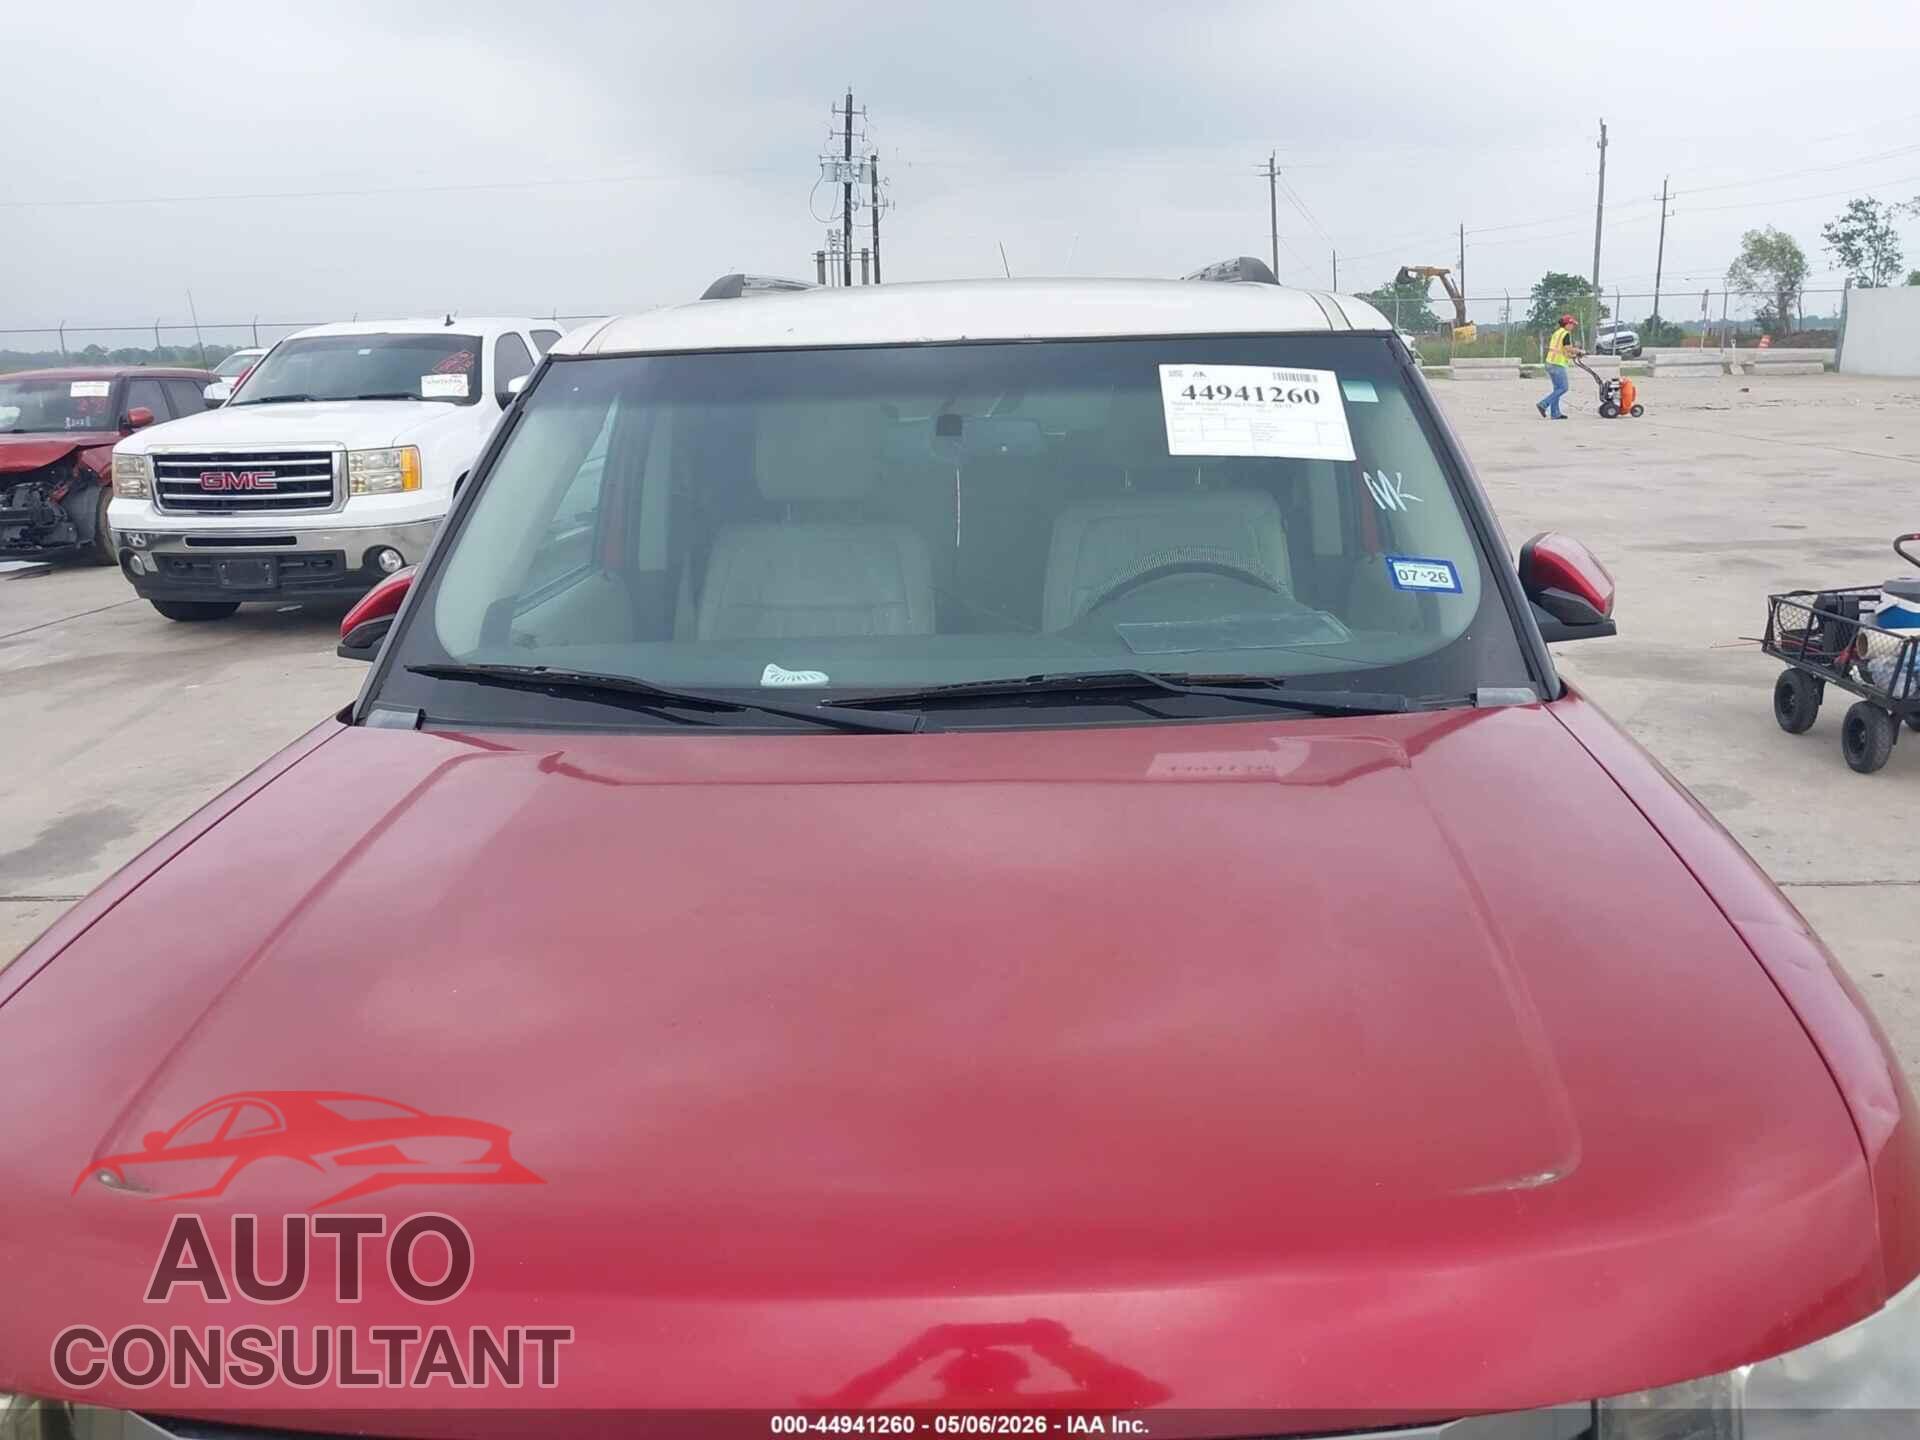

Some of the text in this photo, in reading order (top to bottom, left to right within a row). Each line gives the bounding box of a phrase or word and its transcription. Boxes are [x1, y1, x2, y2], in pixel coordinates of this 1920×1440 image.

[1181, 384, 1320, 404] 44941260
[200, 471, 277, 490] GMC
[1398, 569, 1449, 583] 07 26
